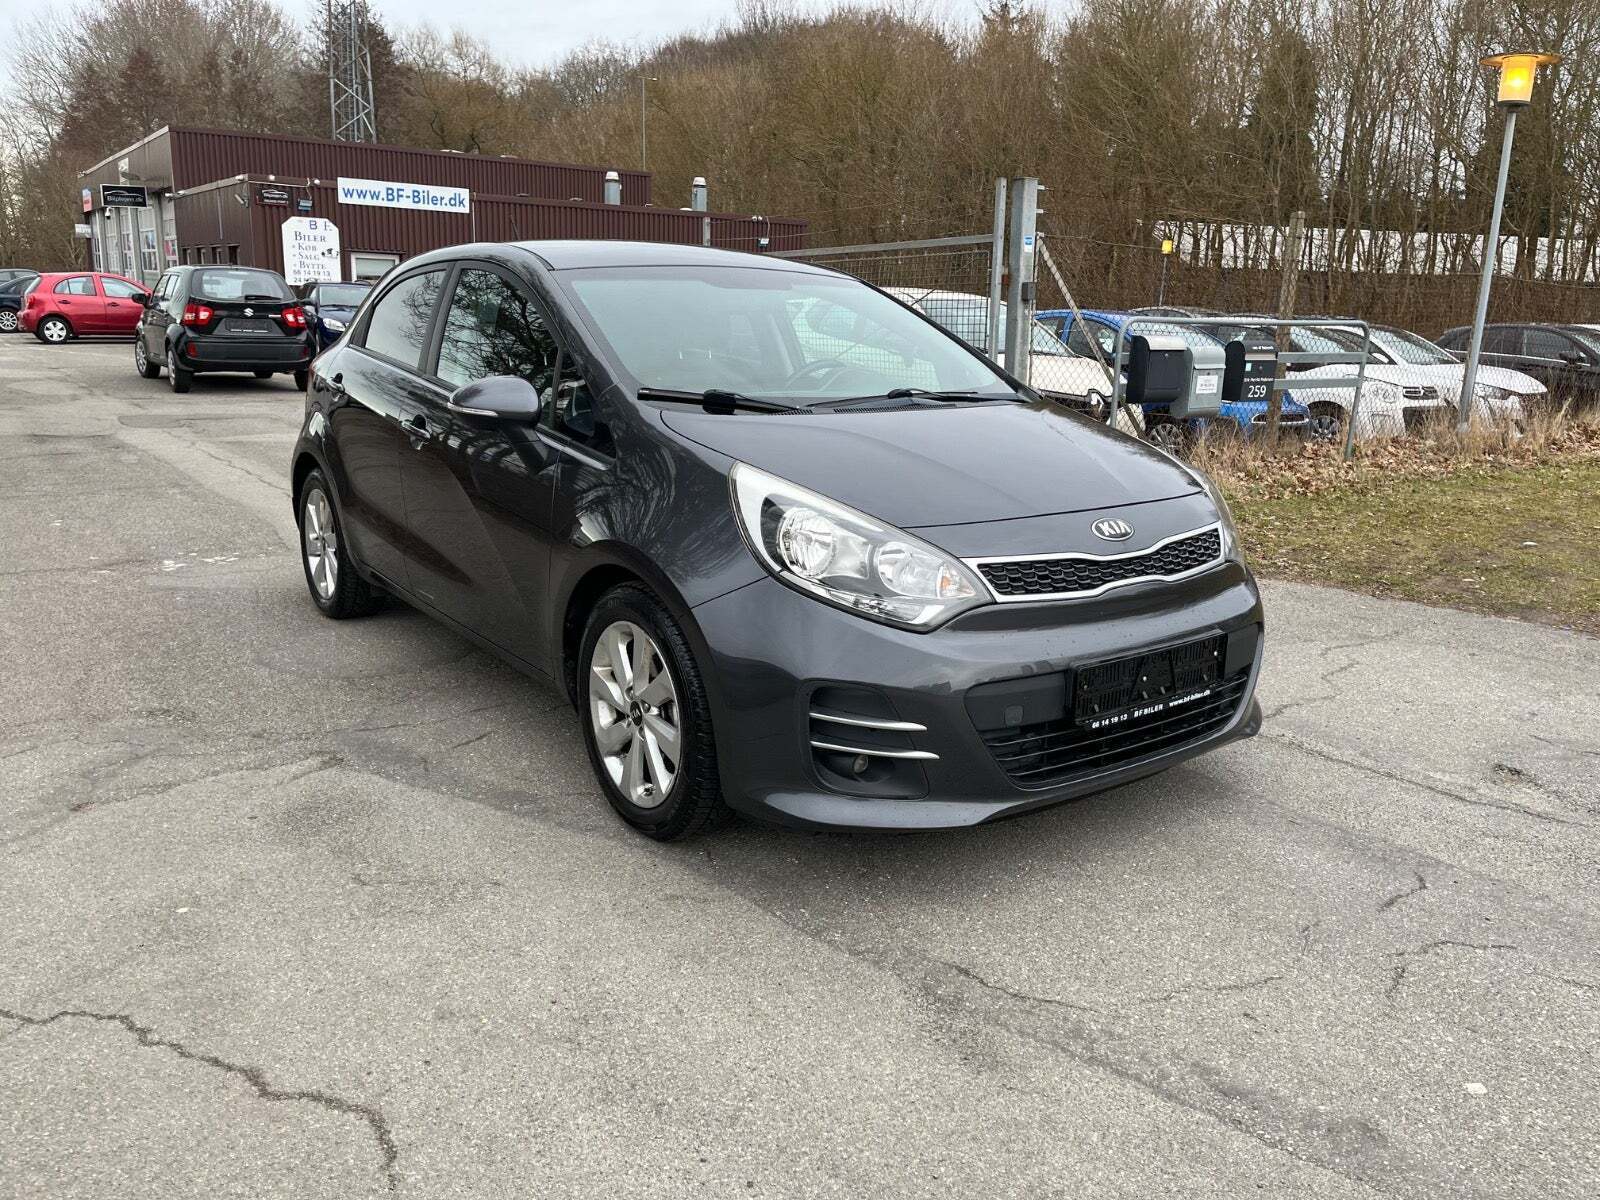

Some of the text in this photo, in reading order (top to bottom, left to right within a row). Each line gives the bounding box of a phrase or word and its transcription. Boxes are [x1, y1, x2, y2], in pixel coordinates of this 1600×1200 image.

[342, 187, 466, 208] www.BF-Biler.dk
[1247, 385, 1267, 398] 259
[1097, 519, 1131, 537] KIA
